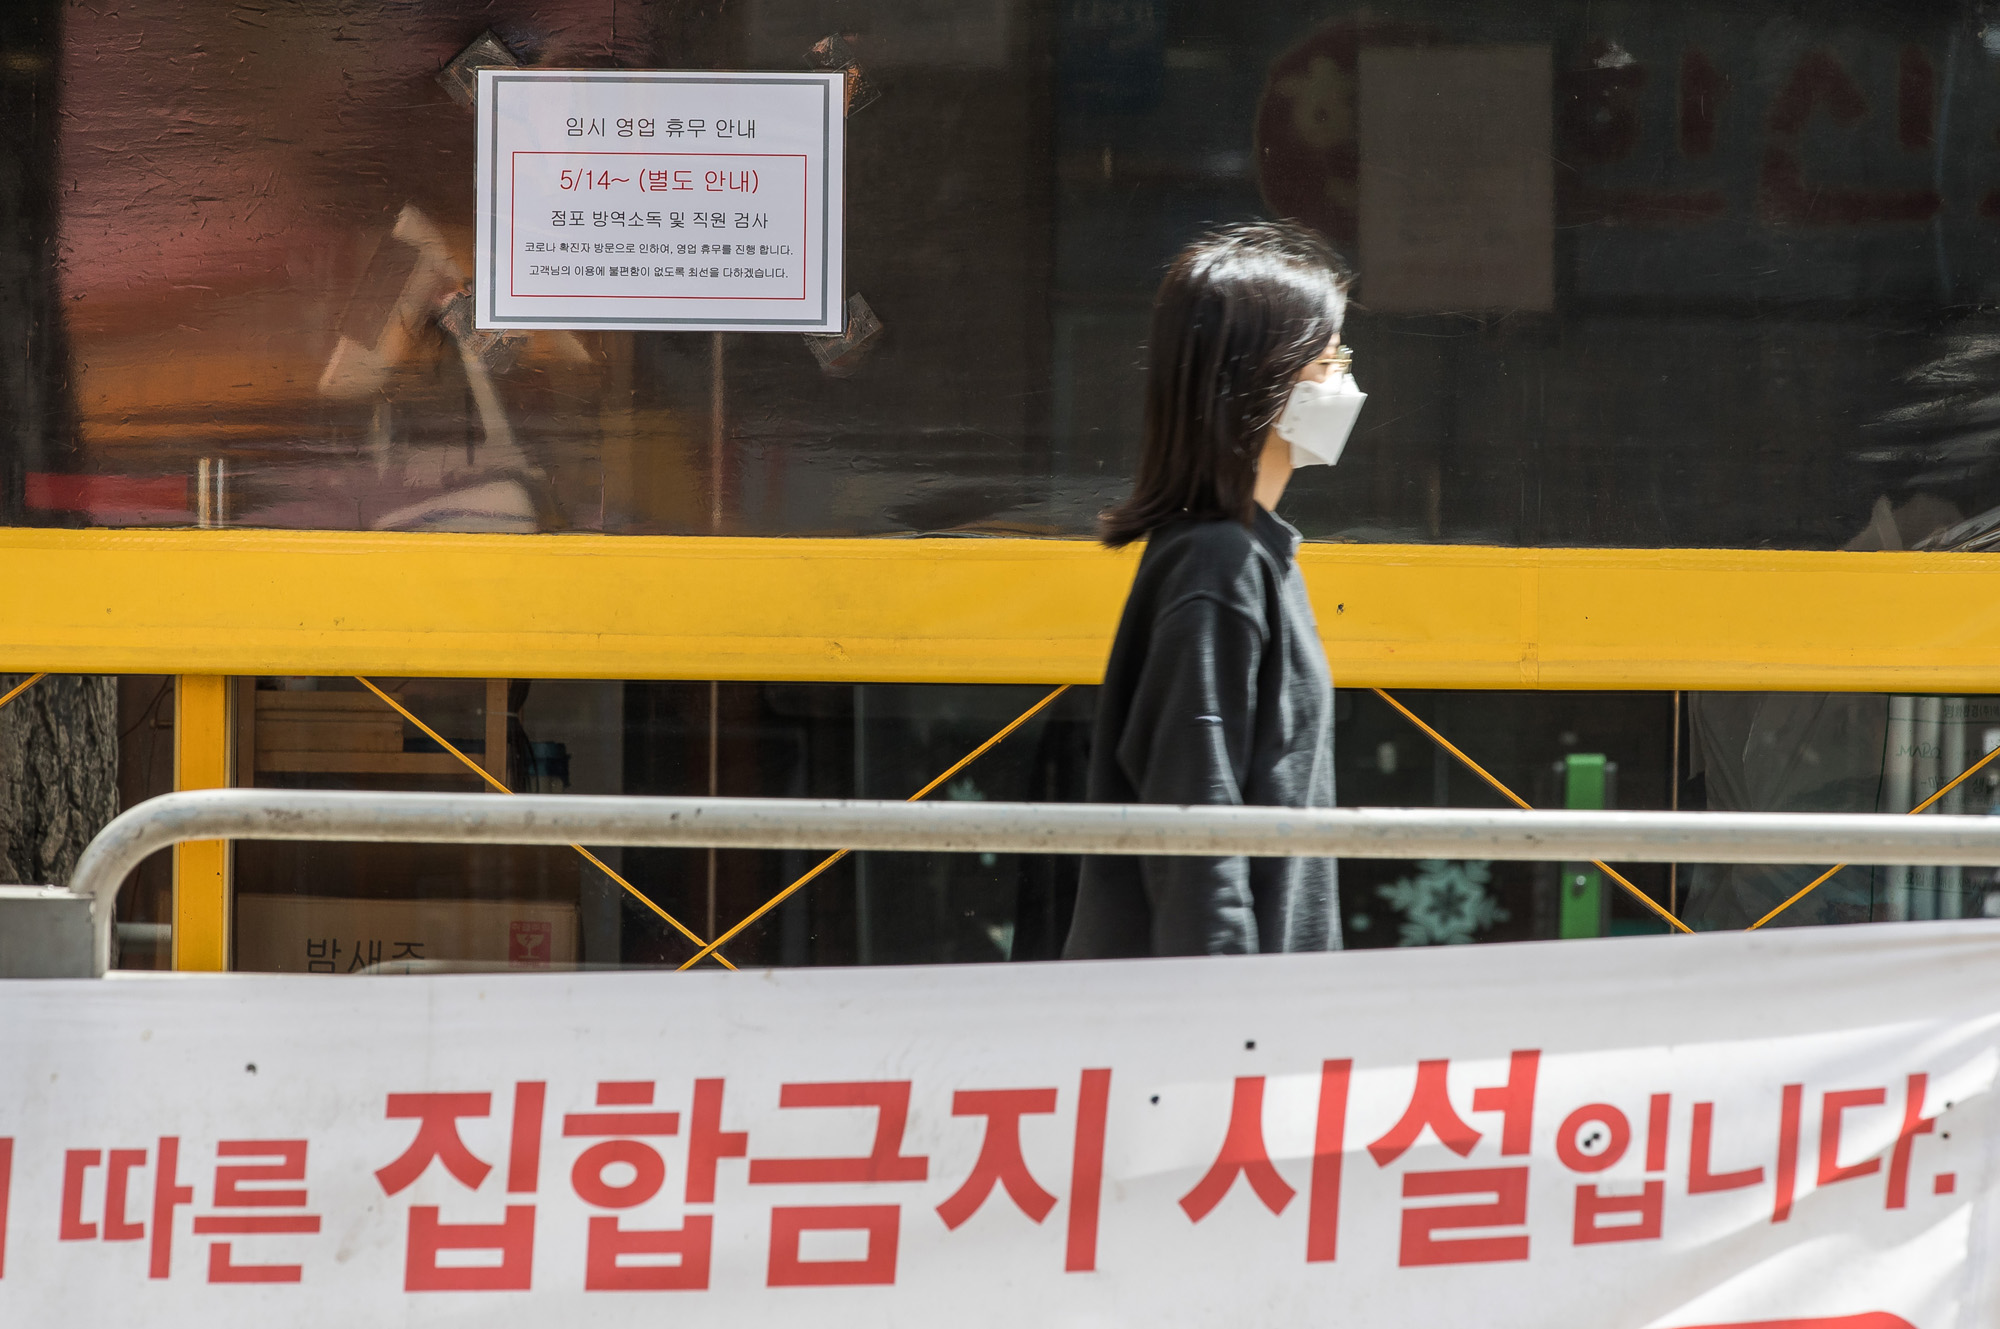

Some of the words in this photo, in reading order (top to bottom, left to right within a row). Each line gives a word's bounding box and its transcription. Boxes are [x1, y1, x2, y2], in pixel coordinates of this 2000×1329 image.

[566, 117, 605, 138] 임시
[616, 117, 655, 138] 영업
[665, 118, 707, 139] 휴무
[715, 119, 755, 139] 안내
[559, 167, 631, 192] 5/14~
[638, 168, 694, 193] (별도
[704, 169, 759, 194] 안내)
[551, 210, 586, 227] 점포
[592, 210, 663, 229] 방역소독
[669, 211, 685, 229] 및
[692, 211, 726, 229] 직원
[733, 212, 769, 230] 검사
[524, 241, 557, 253] 코로나
[559, 242, 591, 254] 확진자
[593, 242, 636, 254] 방문으로
[638, 243, 674, 255] 인하여,
[676, 243, 697, 255] 영업
[700, 243, 732, 256] 휴무를
[734, 244, 756, 256] 진행
[759, 244, 794, 256] 합니다.
[529, 265, 571, 276] 고객님의
[574, 265, 606, 277] 이용에
[608, 265, 650, 278] 불편함이
[653, 266, 686, 278] 없도록
[687, 266, 720, 278] 최선을
[722, 267, 789, 279] 다하겠습니다.
[306, 938, 425, 975] 밤새주
[60, 1137, 320, 1284] 따른
[375, 1069, 1111, 1292] 집합금지
